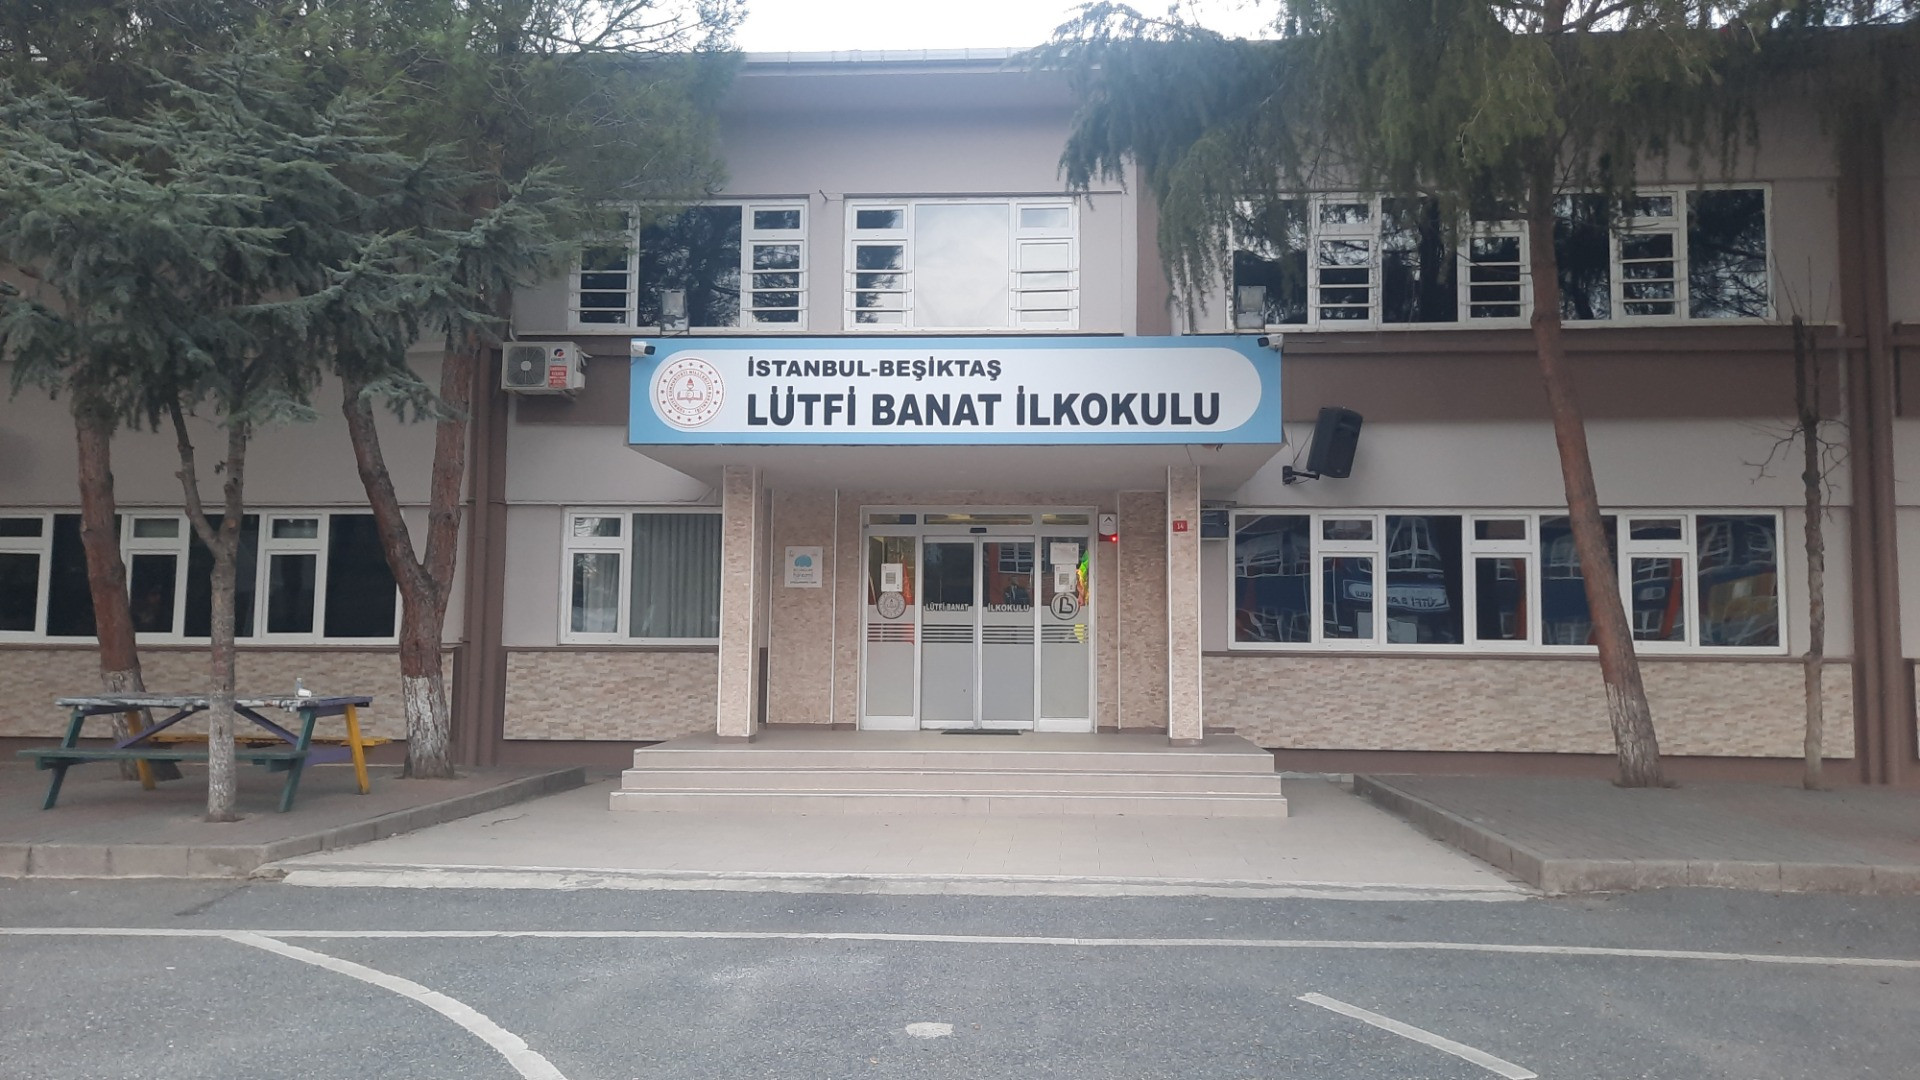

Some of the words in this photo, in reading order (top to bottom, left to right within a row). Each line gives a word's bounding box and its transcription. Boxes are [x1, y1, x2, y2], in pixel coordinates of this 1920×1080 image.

[747, 356, 1002, 381] İSTANBUL-BEŞİKTAŞ
[747, 385, 856, 426] LÜTFİ
[872, 393, 1002, 426] BANAT
[1016, 385, 1220, 426] İLKOKULU
[946, 602, 969, 612] BANAT
[987, 602, 1030, 612] İLKOKULU
